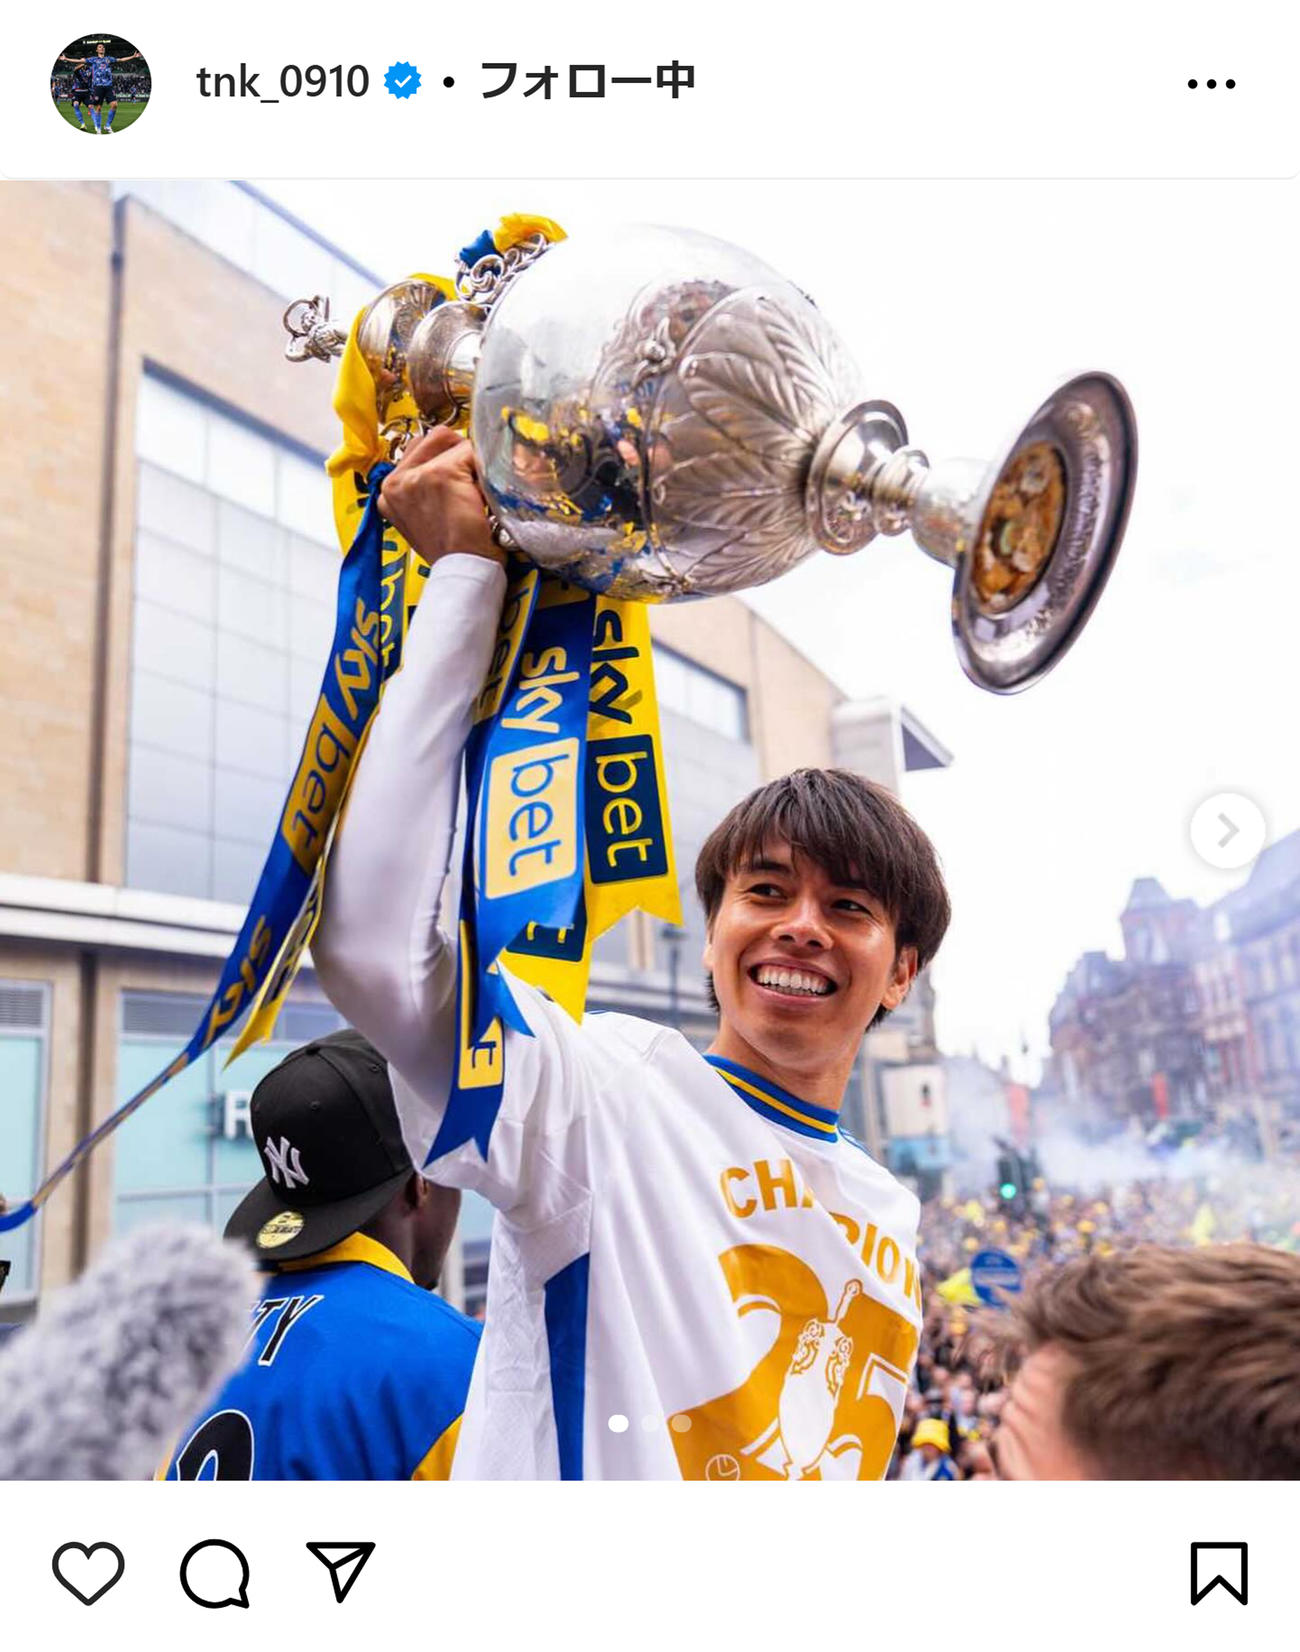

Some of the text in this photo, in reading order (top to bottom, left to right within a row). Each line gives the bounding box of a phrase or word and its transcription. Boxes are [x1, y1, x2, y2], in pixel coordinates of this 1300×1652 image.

[335, 597, 380, 720] sky
[501, 646, 580, 734] sky
[292, 723, 351, 846] bet
[589, 609, 653, 867] sky bet
[509, 753, 569, 877] bet
